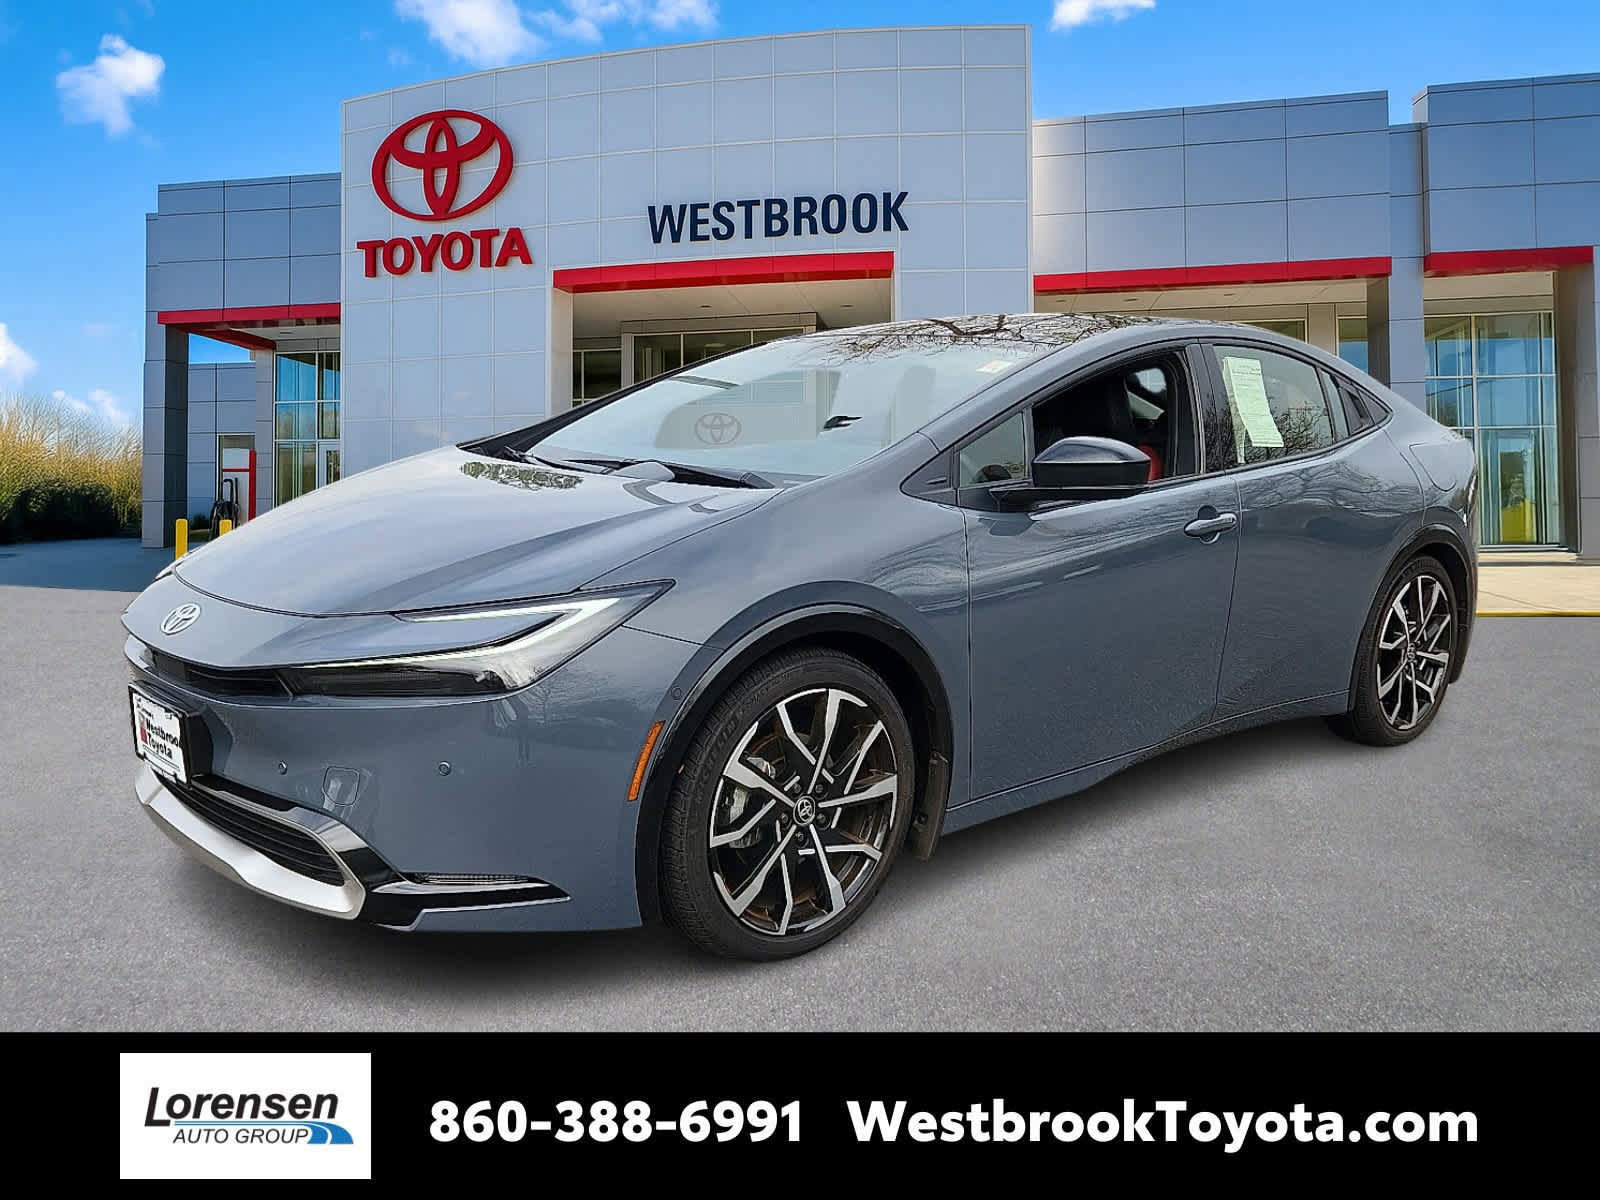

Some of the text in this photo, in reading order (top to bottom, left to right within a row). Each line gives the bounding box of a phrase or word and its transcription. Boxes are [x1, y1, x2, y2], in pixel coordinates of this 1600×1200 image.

[647, 191, 910, 244] WESTBROOK
[357, 227, 533, 278] TOYOTA
[147, 732, 173, 759] Toyota
